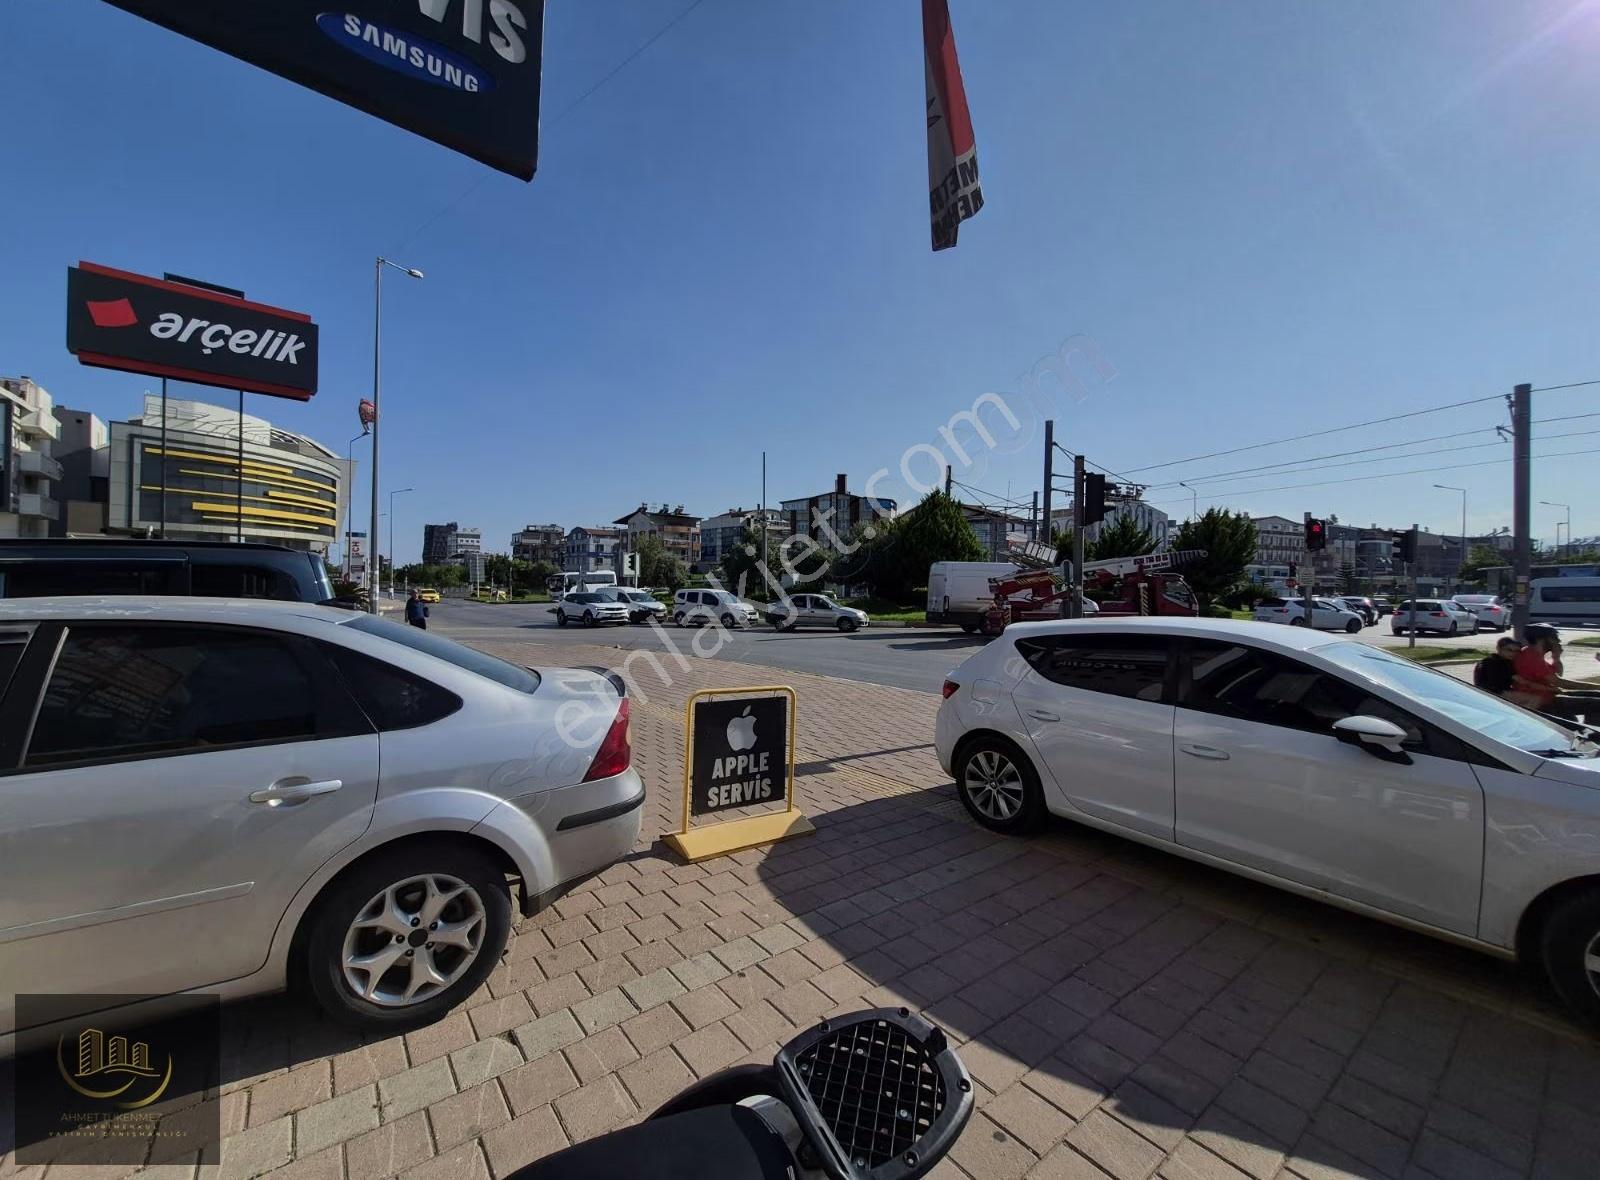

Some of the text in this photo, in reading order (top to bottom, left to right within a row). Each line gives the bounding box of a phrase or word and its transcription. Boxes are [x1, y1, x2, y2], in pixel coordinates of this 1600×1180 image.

[343, 13, 480, 94] SAMSUNG
[150, 312, 306, 366] arçelik
[711, 751, 770, 780] APPLE
